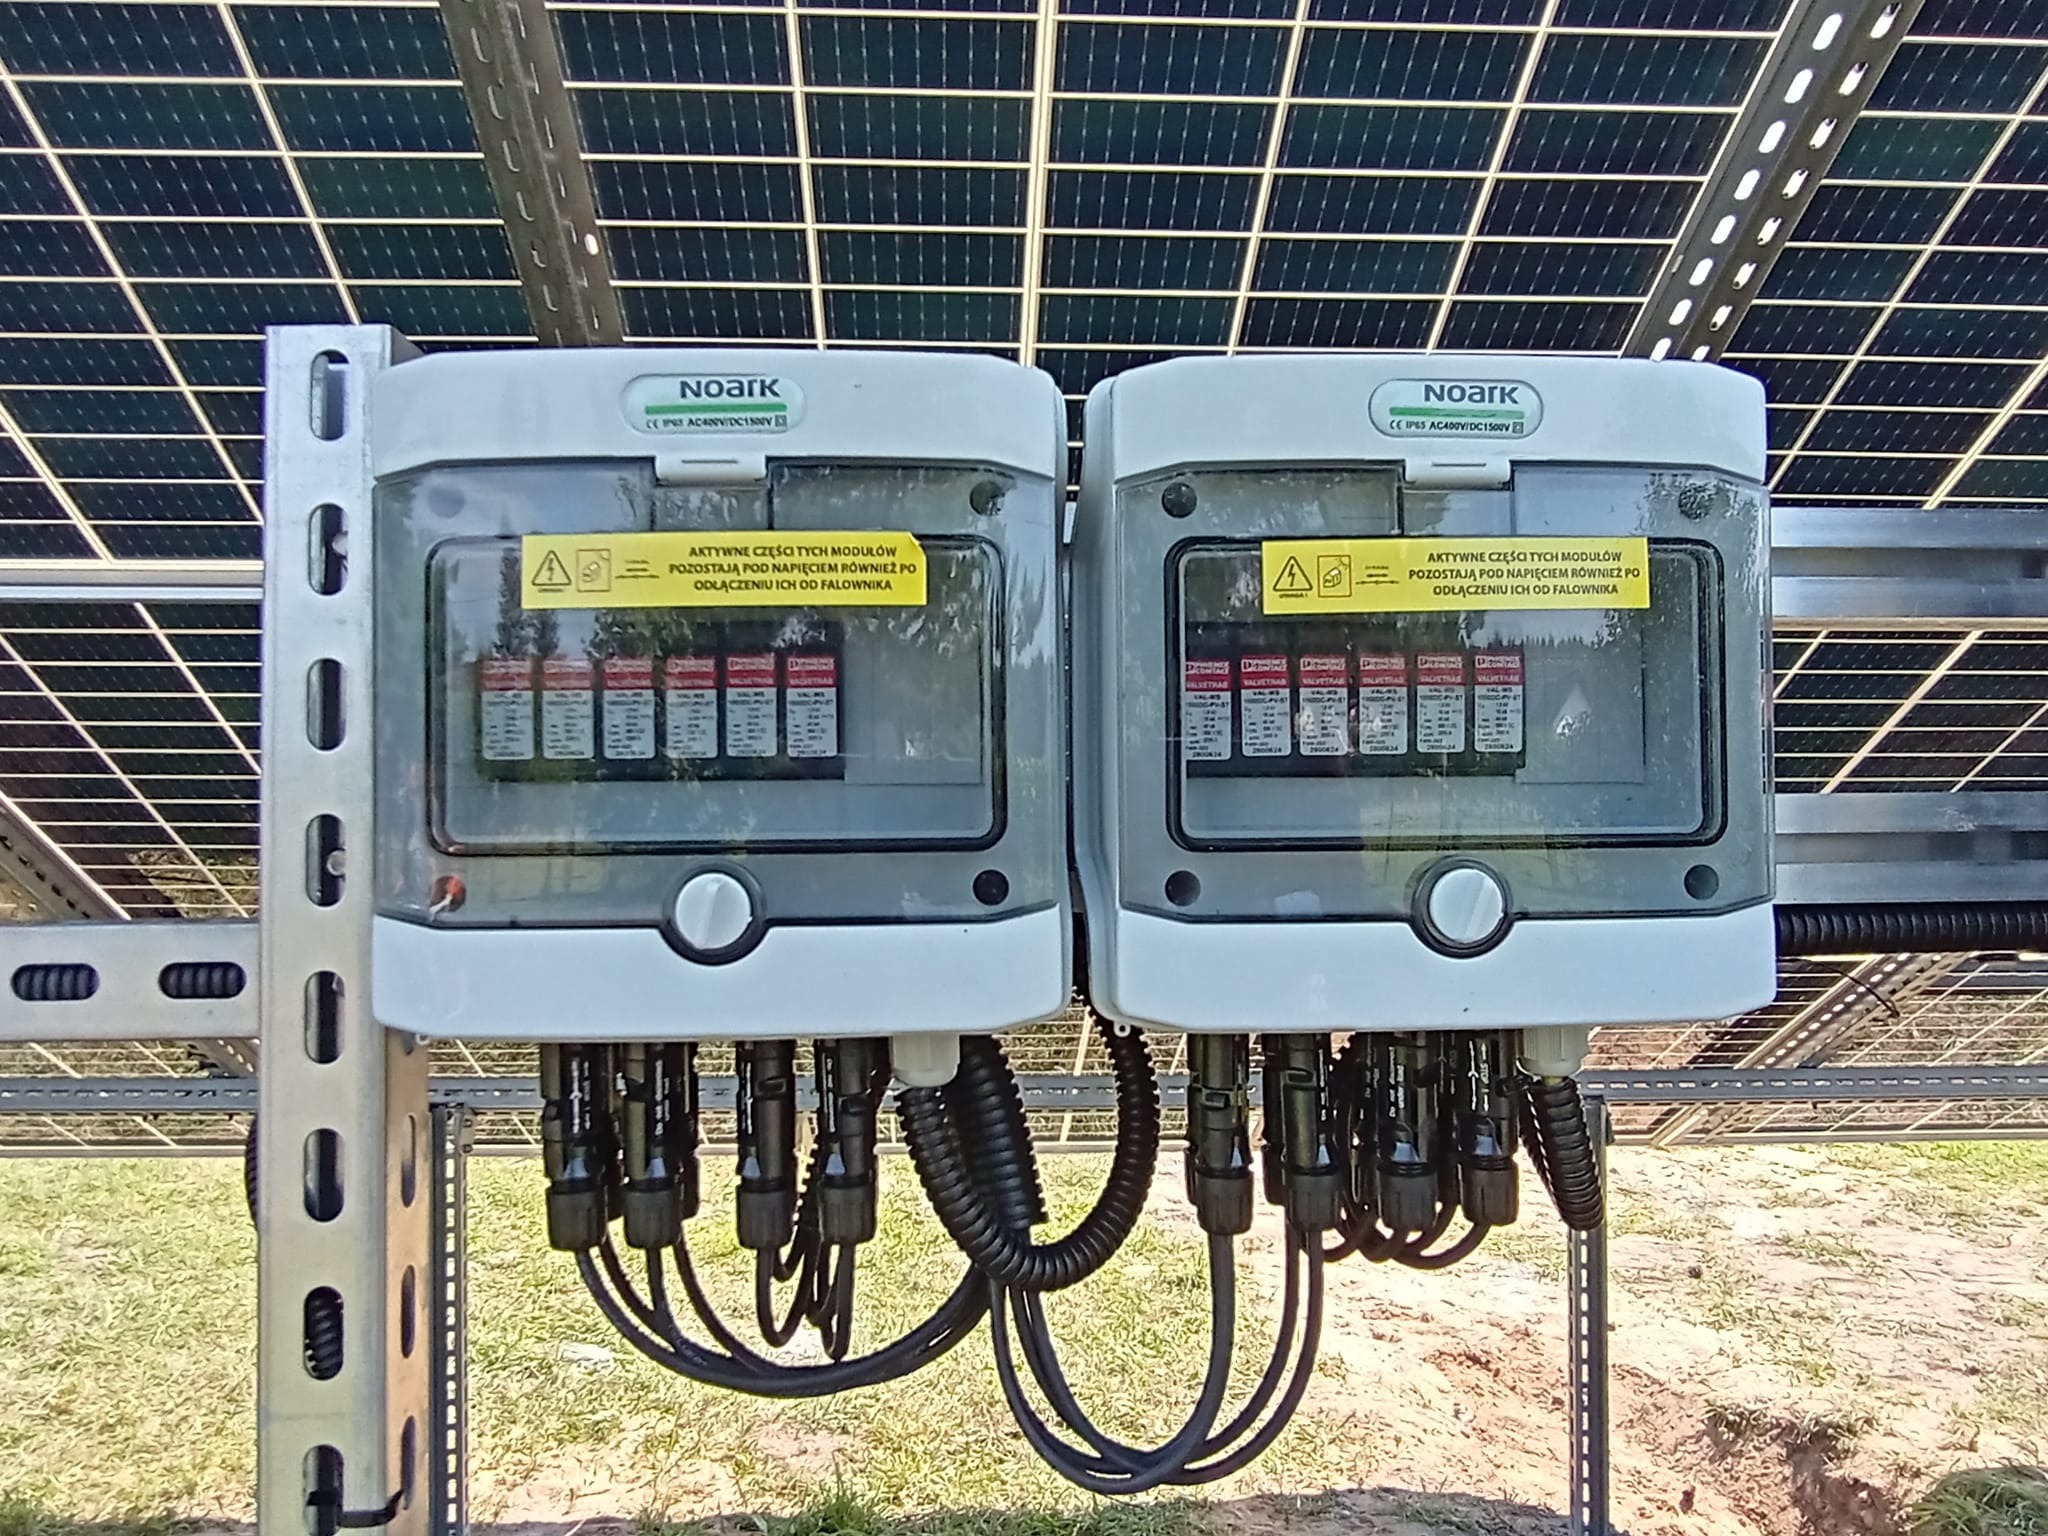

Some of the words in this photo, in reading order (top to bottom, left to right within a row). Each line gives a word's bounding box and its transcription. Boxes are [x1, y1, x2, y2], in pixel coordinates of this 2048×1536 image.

[1405, 420, 1426, 430] IP65
[1428, 420, 1511, 432] AC400V/DC1500V
[688, 545, 750, 558] AKTYWNE
[752, 544, 794, 560] CZĘŚCI
[796, 545, 828, 557] TYCH
[831, 544, 897, 558] MODUŁÓW
[1427, 551, 1487, 563] AKTYWNE
[1488, 550, 1528, 565] CZĘŚCI
[1529, 551, 1559, 562] TYCH
[1561, 549, 1622, 562] MODUŁÓW
[669, 562, 741, 576] POZOSTAJĄ
[742, 562, 770, 574] POD
[772, 562, 839, 576] NAPIĘCIEM
[841, 561, 898, 574] RÓWNIEŻ
[899, 562, 917, 574] PO
[1408, 568, 1477, 582] POZOSTAJĄ
[1479, 567, 1505, 579] POD
[1506, 567, 1569, 581] NAPIĘCIEM
[1571, 566, 1623, 579] RÓWNIEŻ
[1624, 567, 1640, 579] PO
[693, 579, 774, 594] ODŁĄCZENIU
[775, 579, 797, 590] ICH
[799, 579, 819, 590] OD
[820, 579, 893, 591] FALOWNIKA
[1432, 584, 1509, 598] ODŁĄCZENIU
[1510, 584, 1531, 595] ICH
[1532, 584, 1551, 595] OD
[1553, 584, 1619, 595] FALOWNIKA
[1479, 1062, 1489, 1085] STOP
[1388, 1105, 1396, 1118] Do
